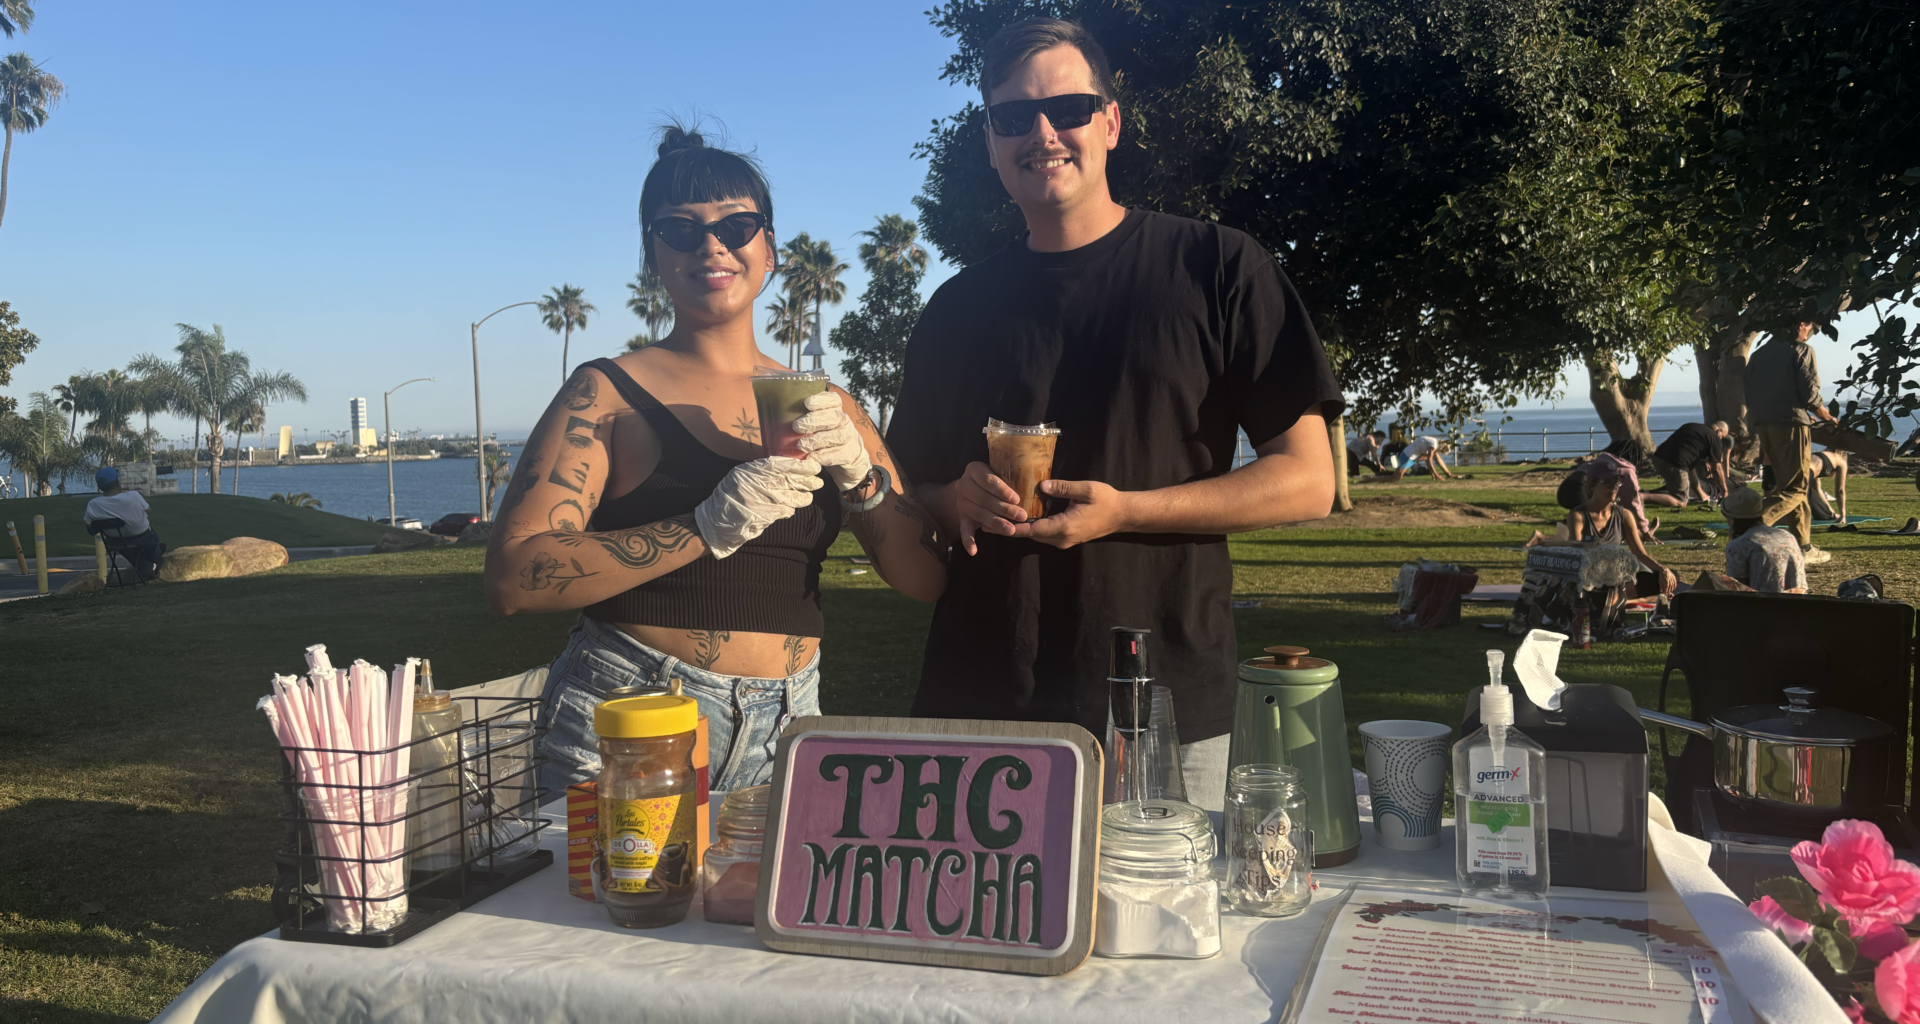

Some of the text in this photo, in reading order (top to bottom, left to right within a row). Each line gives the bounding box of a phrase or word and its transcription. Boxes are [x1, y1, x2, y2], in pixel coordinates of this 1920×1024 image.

[1529, 554, 1571, 569] TAROT READING
[819, 753, 1032, 850] THC
[1473, 794, 1524, 803] ADVANCED
[1480, 803, 1518, 812] moisturizing
[615, 814, 646, 827] Portales
[1233, 817, 1286, 836] House
[1231, 841, 1296, 866] Keeping
[1244, 870, 1280, 892] Tips
[796, 842, 1042, 946] MATCHA
[1386, 933, 1425, 941] Matcha
[1454, 940, 1500, 948] Oatmilk
[1446, 952, 1492, 960] Oatmilk
[1568, 964, 1639, 975] Cheesecake
[1372, 959, 1412, 967] Matcha
[1444, 966, 1490, 975] Oatmilk
[1569, 979, 1606, 987] Sweet
[1609, 983, 1681, 995] Strawberry
[1699, 980, 1716, 988] 10
[1365, 983, 1516, 1003] caramelized brown sugar
[1367, 976, 1409, 984] Matcha
[1526, 990, 1576, 1000] Oatmilk
[1580, 996, 1623, 1005] topped
[1358, 1001, 1389, 1009] Made
[1422, 1007, 1472, 1017] Oatmilk
[1702, 997, 1719, 1005] 10
